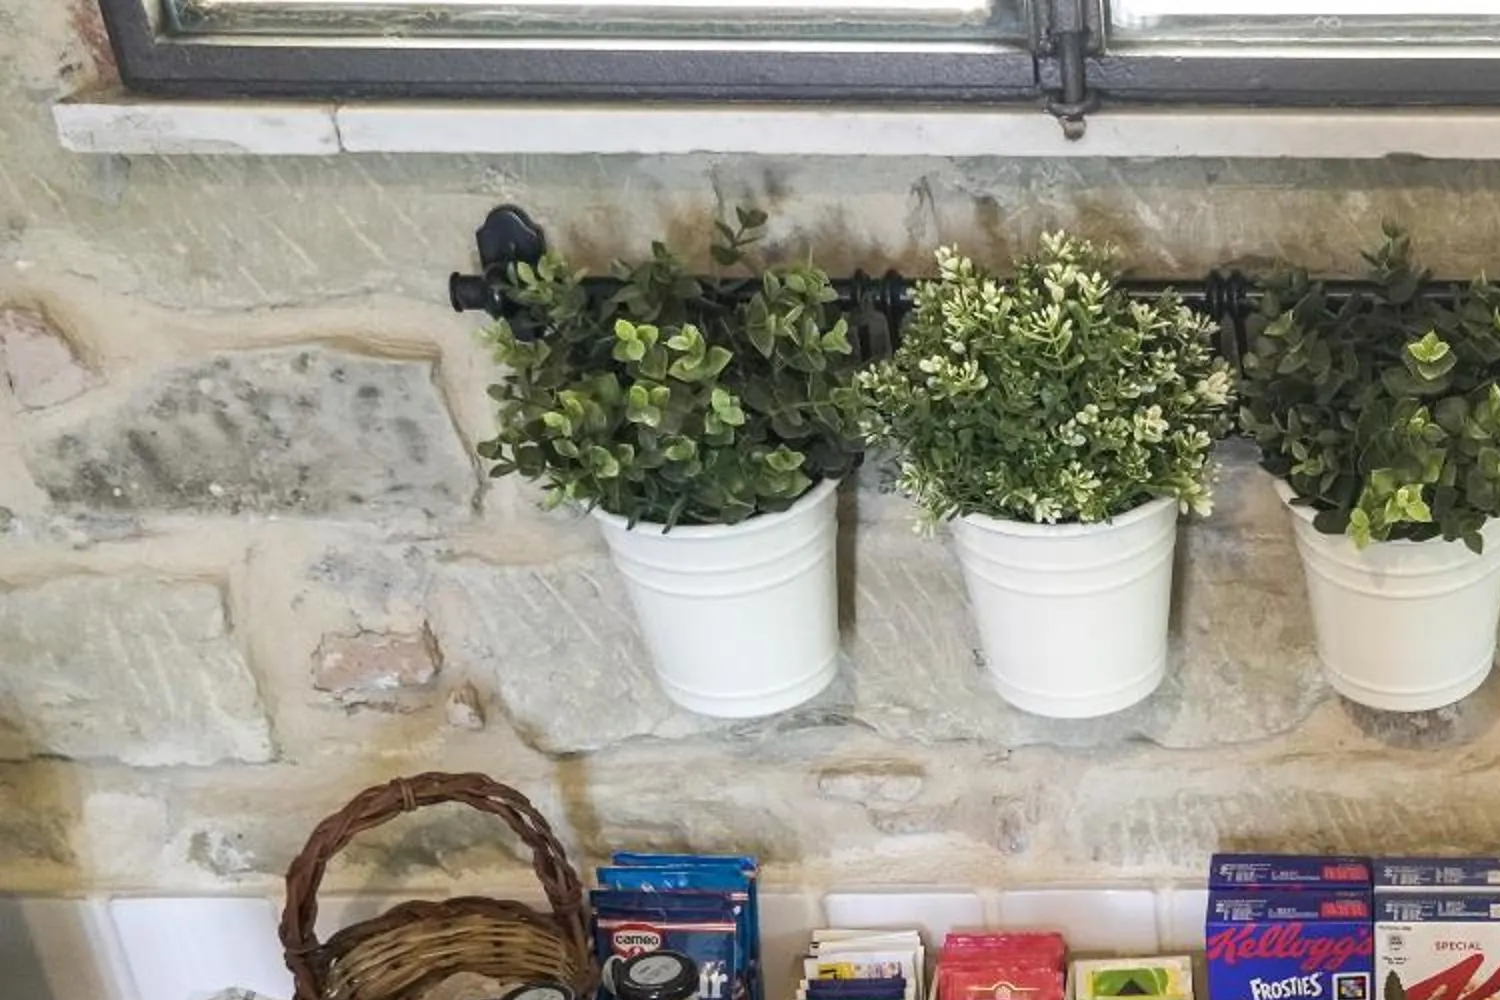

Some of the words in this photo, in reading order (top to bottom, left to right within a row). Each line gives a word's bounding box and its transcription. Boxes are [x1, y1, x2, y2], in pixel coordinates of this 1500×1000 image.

[615, 935, 659, 946] cameo
[1205, 922, 1373, 970] Kellogg's
[1434, 940, 1482, 951] SPECIAL
